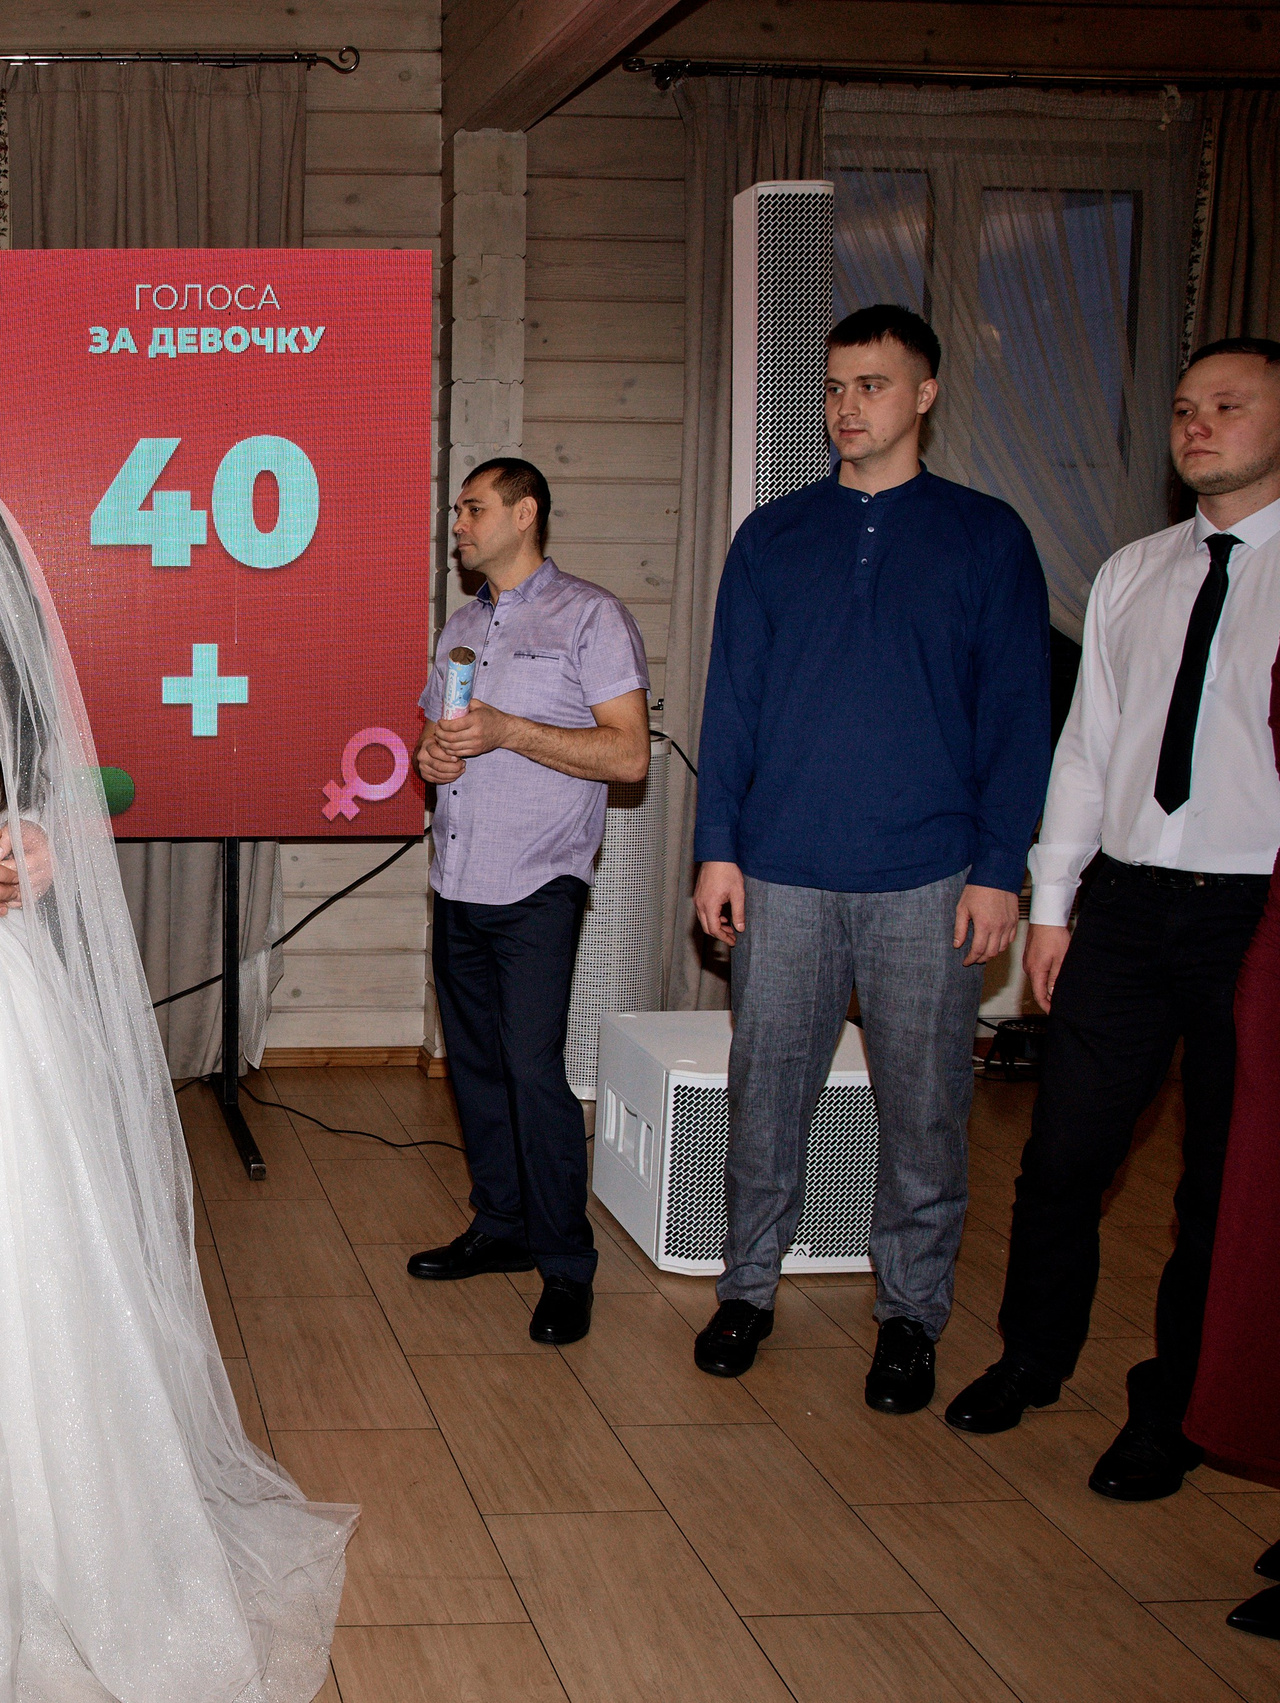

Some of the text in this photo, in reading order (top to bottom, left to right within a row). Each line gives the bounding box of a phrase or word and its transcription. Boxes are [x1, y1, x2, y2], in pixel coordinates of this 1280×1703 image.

[134, 284, 281, 311] ГОЛОСА
[88, 326, 326, 358] ЗА ДЕВОЧКУ
[90, 434, 320, 570] 40
